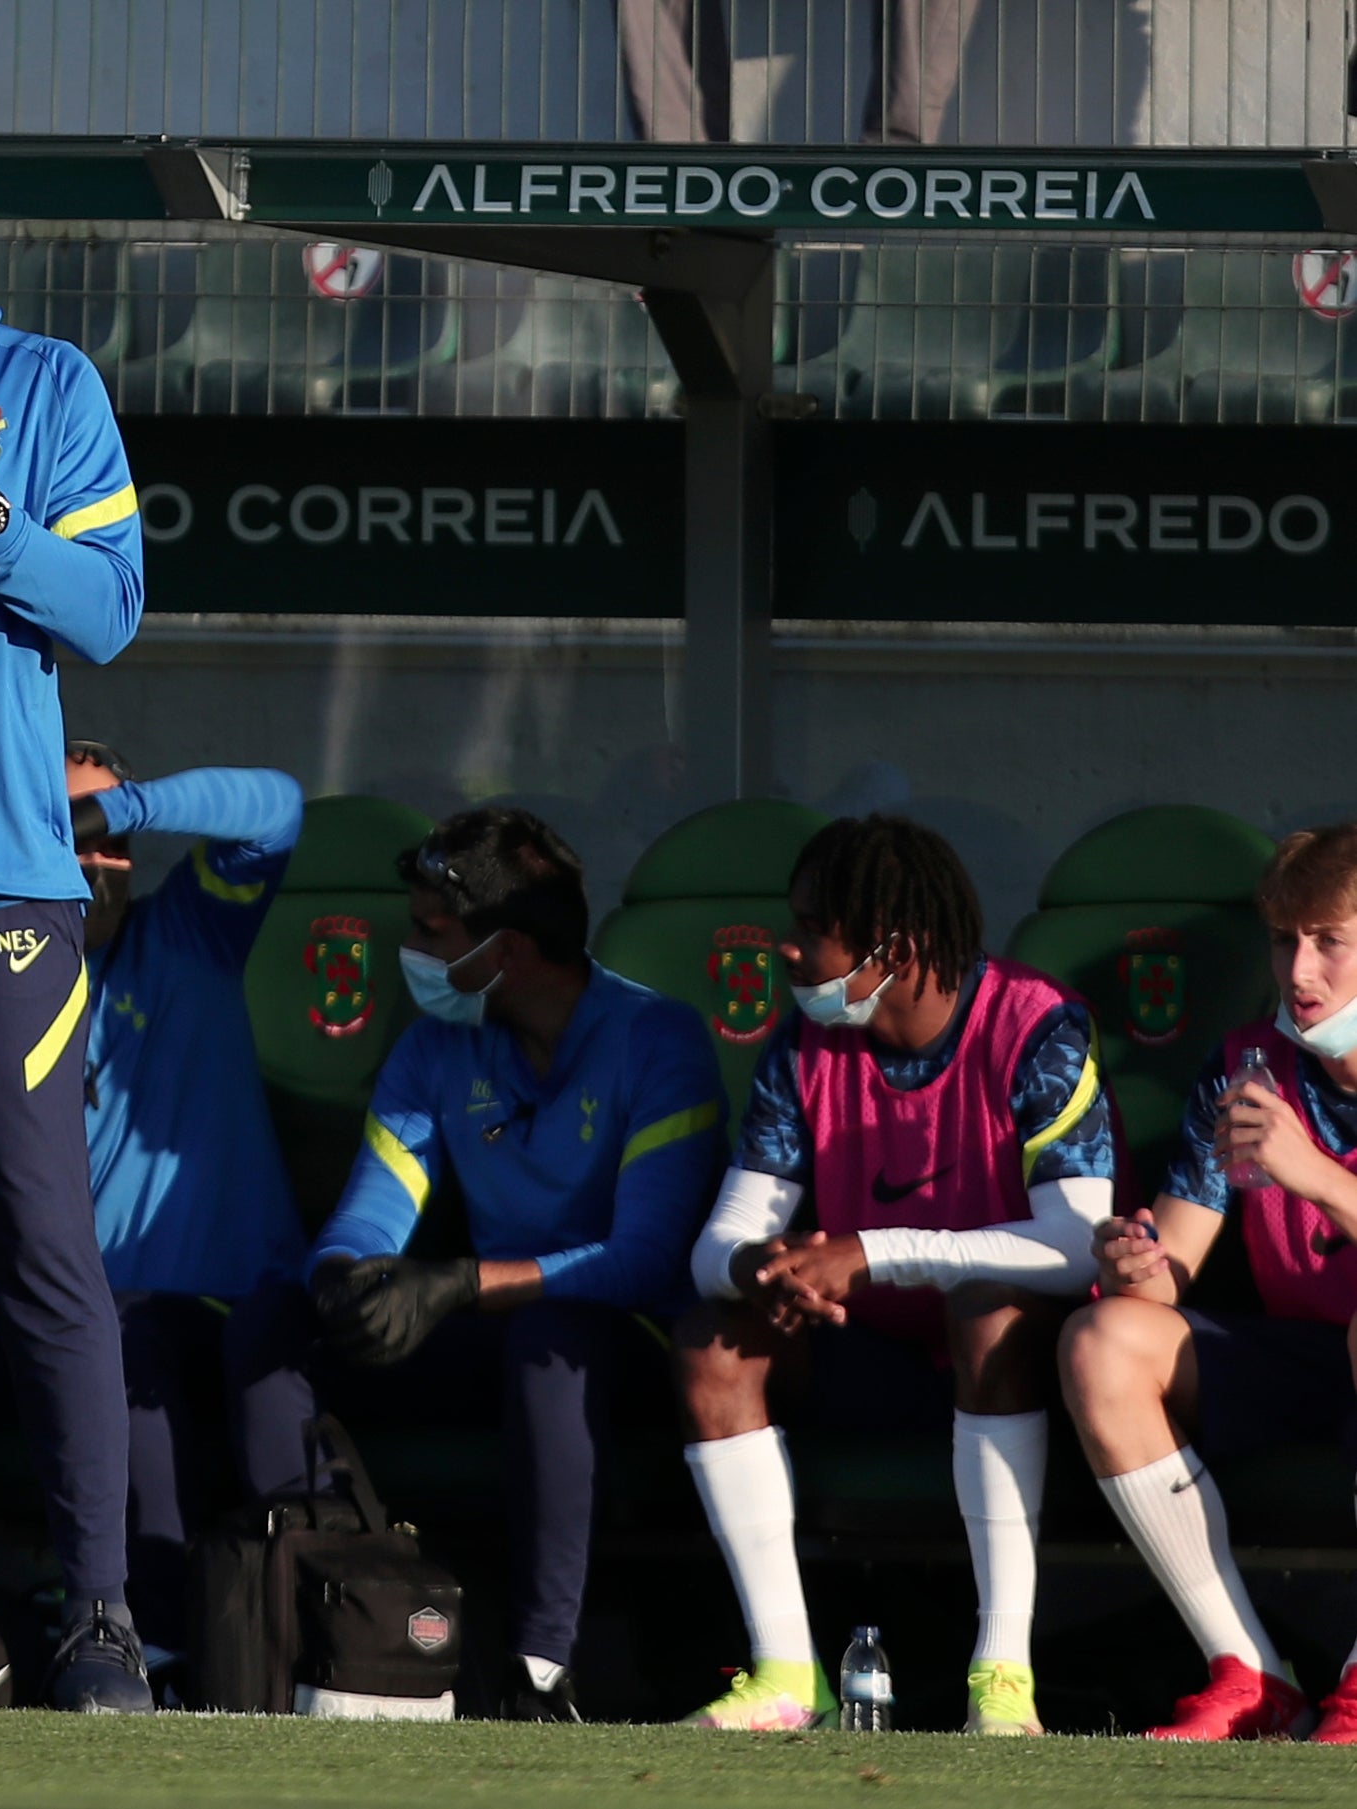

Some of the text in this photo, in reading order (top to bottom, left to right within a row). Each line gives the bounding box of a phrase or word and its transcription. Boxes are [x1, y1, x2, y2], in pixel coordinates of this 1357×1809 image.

[412, 164, 1155, 220] ALFREDO CORREIA
[227, 484, 623, 545] CORREIA
[901, 492, 1330, 554] ALFREDO
